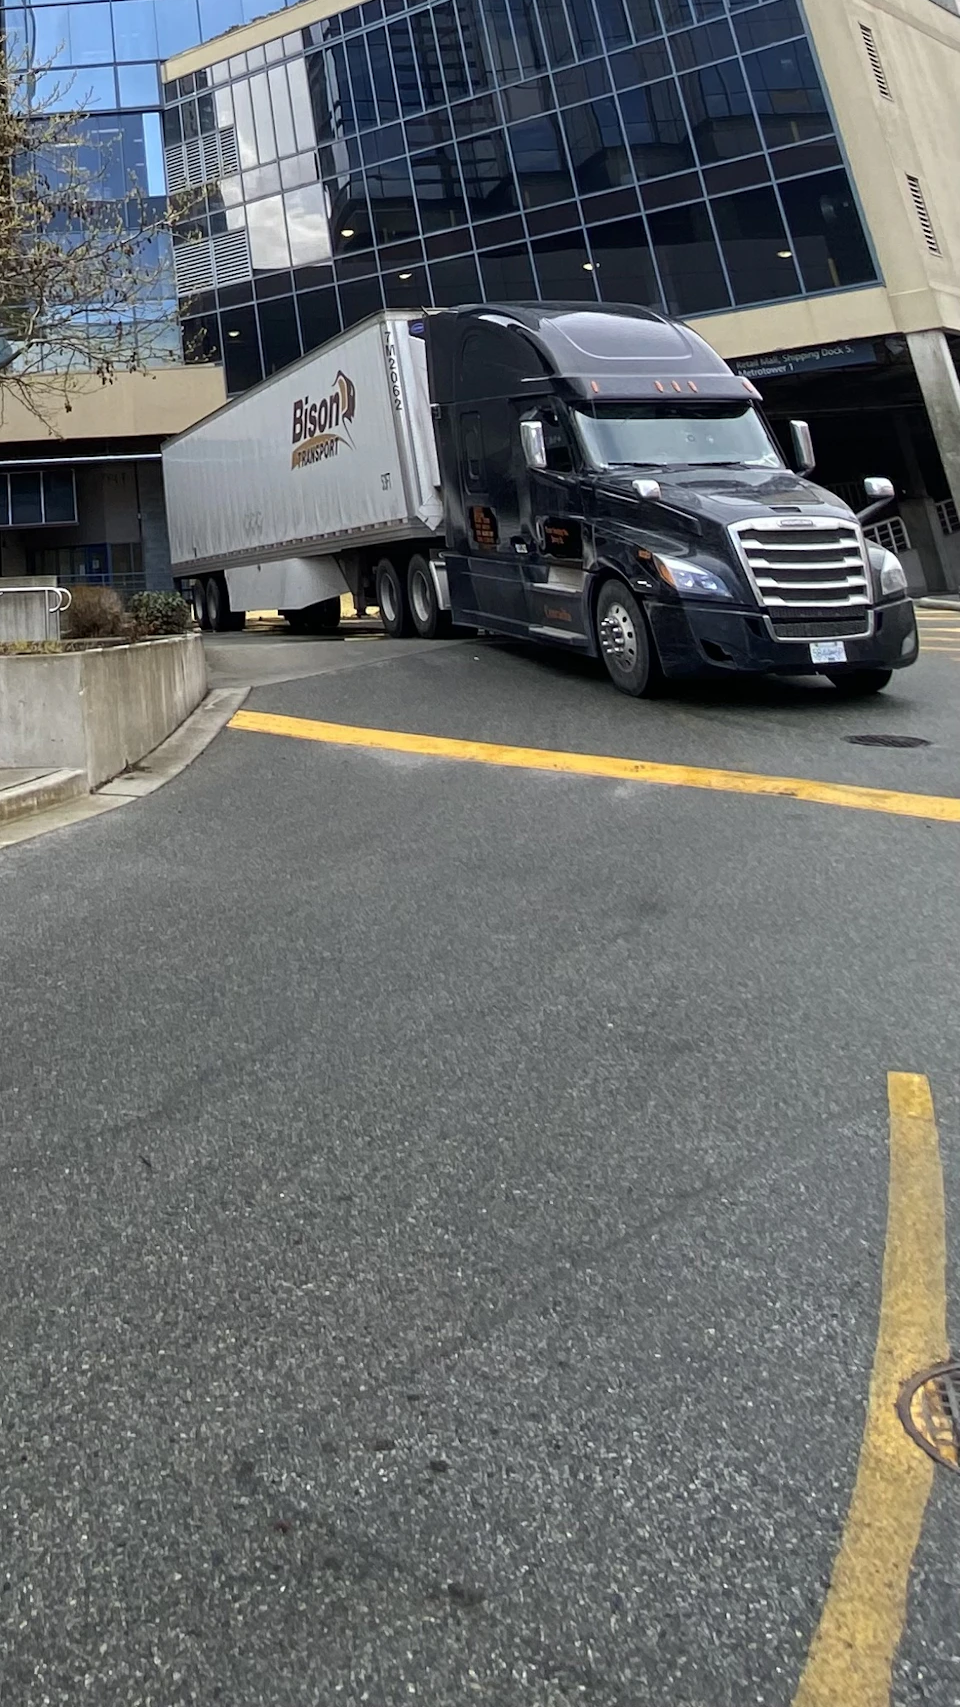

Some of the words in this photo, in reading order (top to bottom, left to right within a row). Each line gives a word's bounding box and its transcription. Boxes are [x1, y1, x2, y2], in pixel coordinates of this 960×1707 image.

[384, 331, 403, 411] 7M2062
[736, 359, 759, 369] Retail
[782, 350, 820, 364] Shipping
[821, 345, 843, 357] Dock
[738, 365, 787, 377] Metrotower
[789, 362, 794, 371] 1
[292, 391, 340, 444] Bison
[297, 436, 339, 468] TRANSPORT
